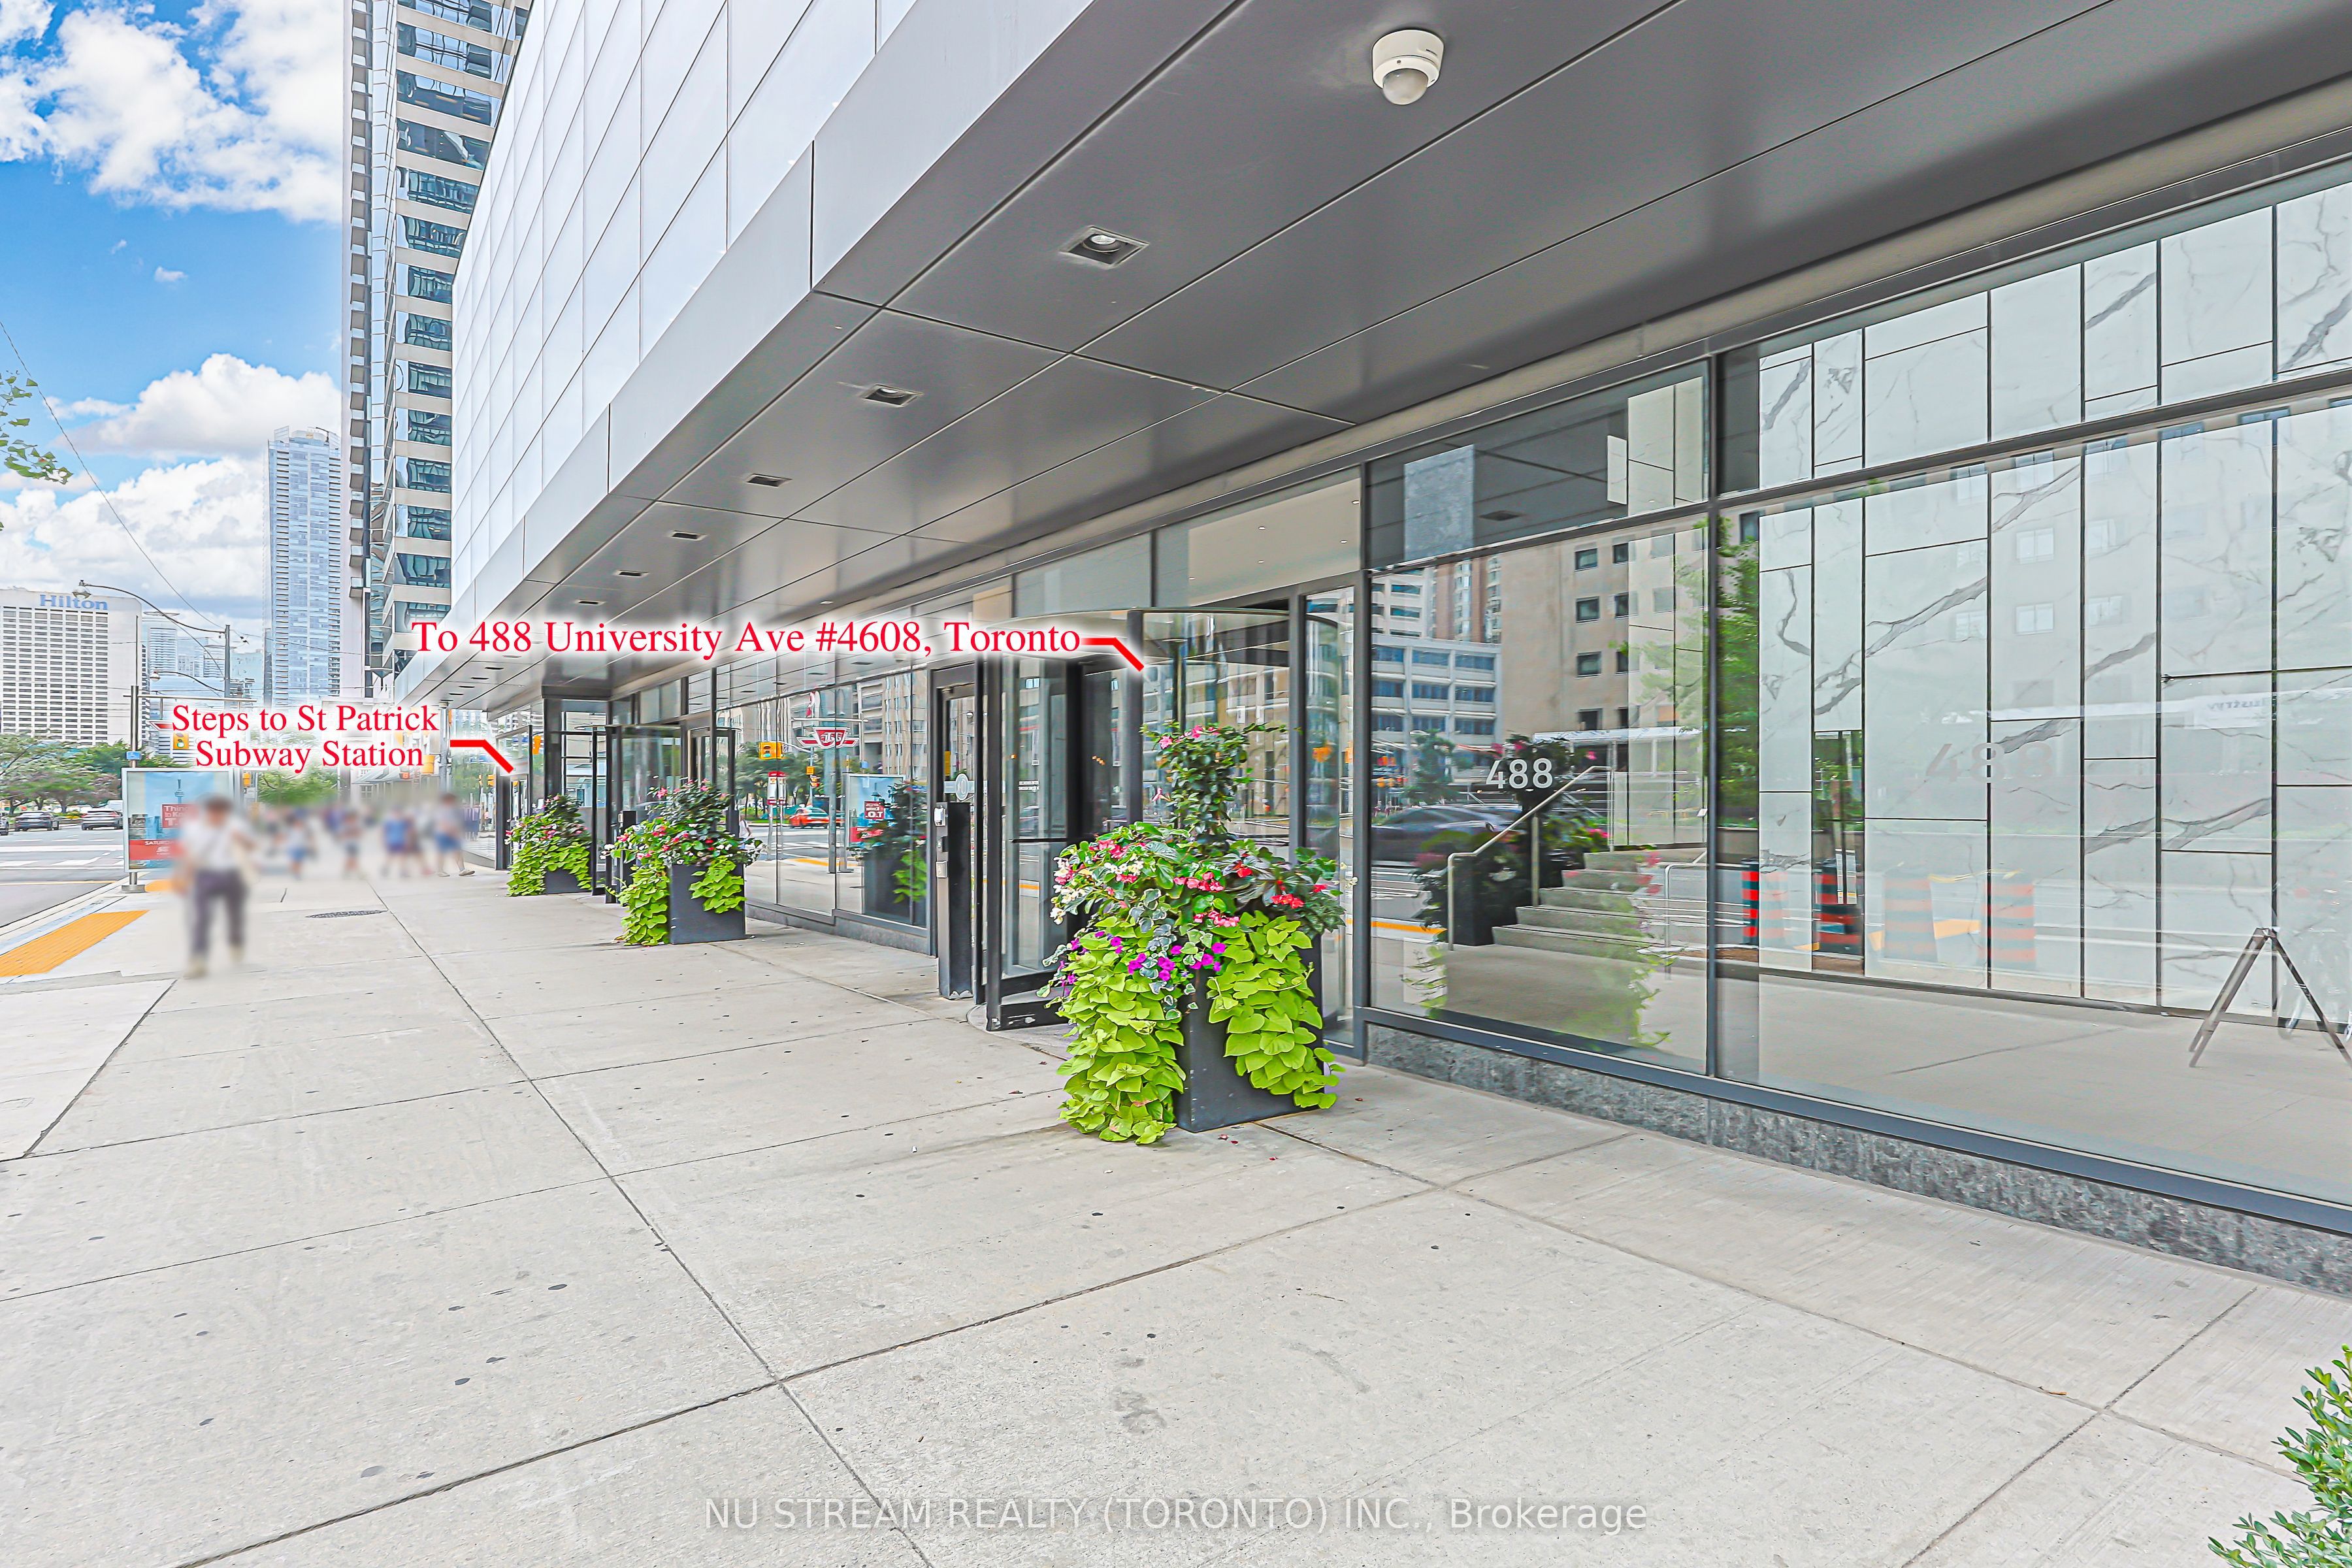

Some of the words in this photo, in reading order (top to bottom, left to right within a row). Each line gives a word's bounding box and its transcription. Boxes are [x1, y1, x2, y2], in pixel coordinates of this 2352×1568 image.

[40, 594, 108, 610] Hilton
[1486, 758, 1553, 789] 488
[1925, 742, 2053, 783] 488
